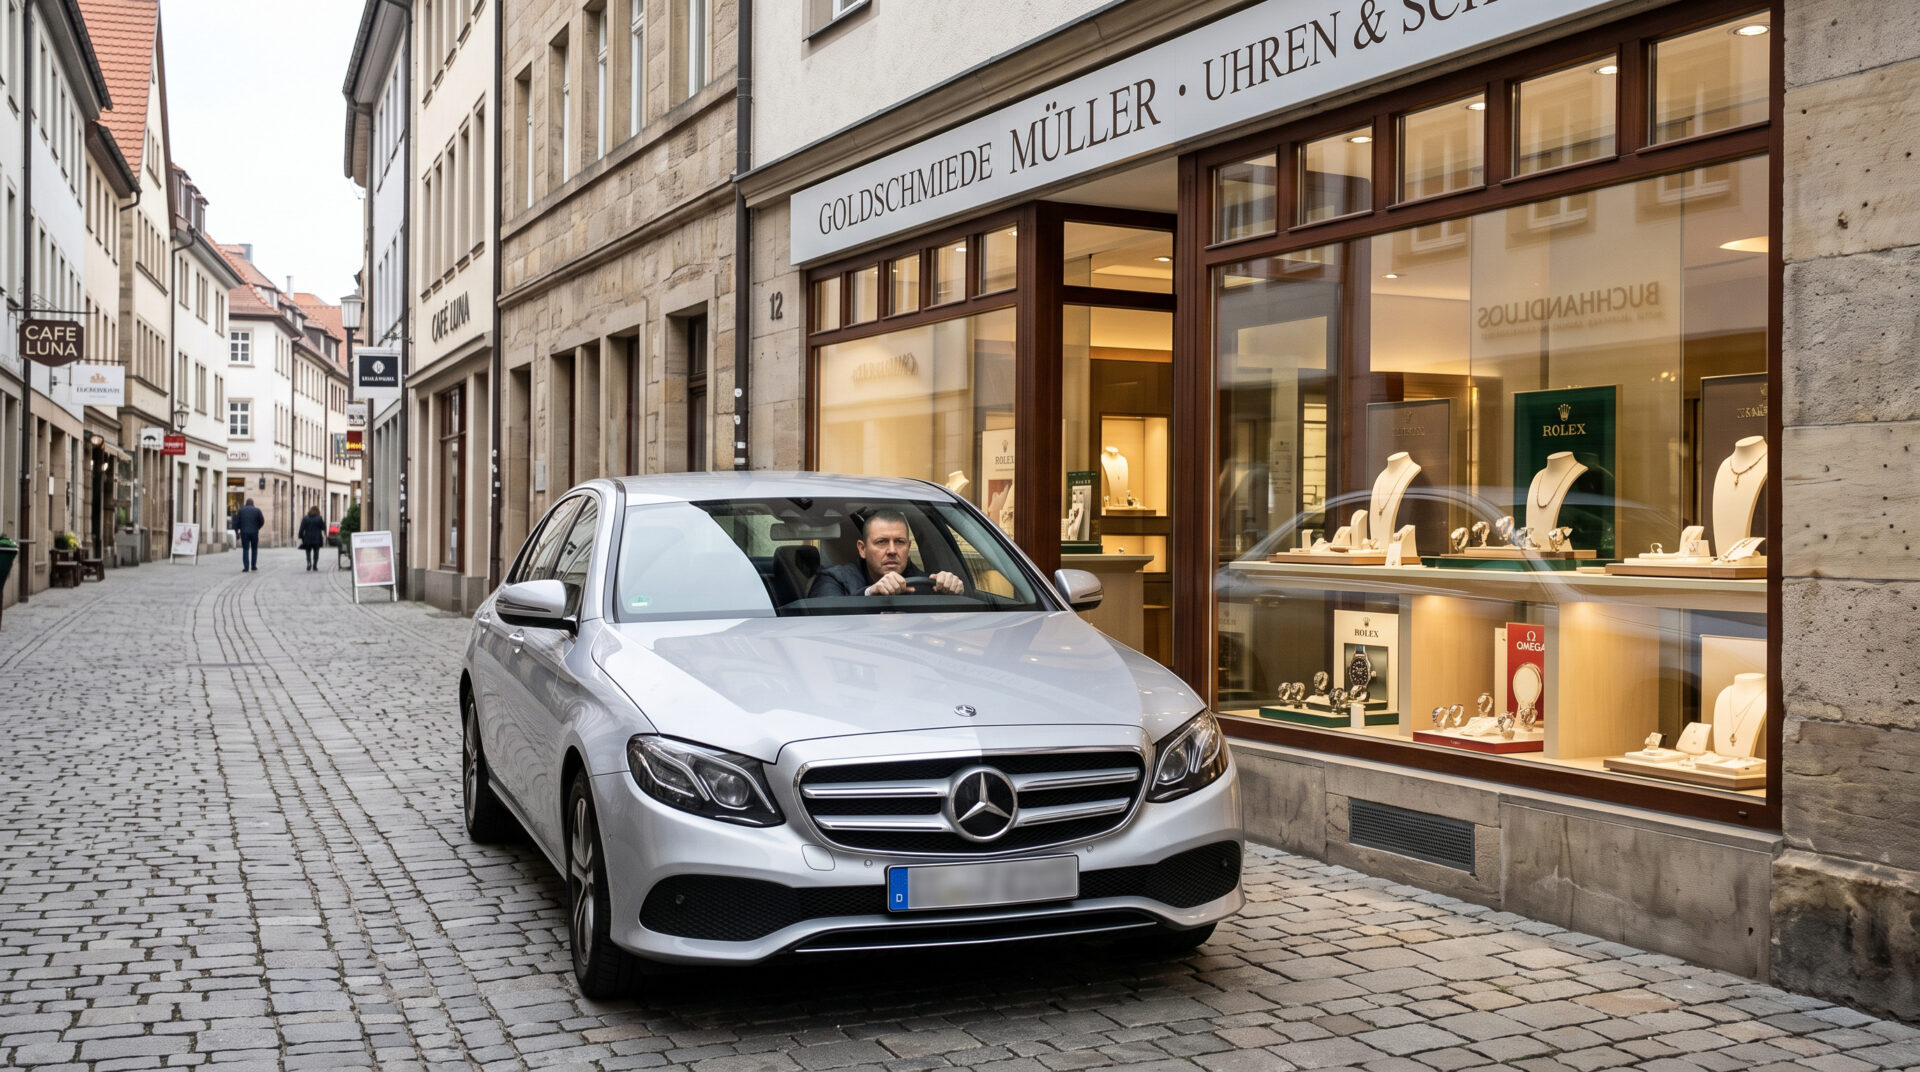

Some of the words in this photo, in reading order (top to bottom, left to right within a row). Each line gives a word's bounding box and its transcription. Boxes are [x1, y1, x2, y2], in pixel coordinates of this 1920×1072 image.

[818, 141, 994, 235] GOLDSCHMIEDE
[1009, 78, 1162, 175] MÜLLER
[1202, 10, 1342, 101] UHREN
[1353, 0, 1388, 50] &
[449, 290, 471, 331] LUNA
[769, 291, 783, 321] 12
[25, 325, 77, 341] CAFE
[26, 340, 78, 357] LUNA
[1542, 423, 1587, 437] ROLEX
[1354, 628, 1379, 638] ROLEX
[896, 893, 903, 903] D
